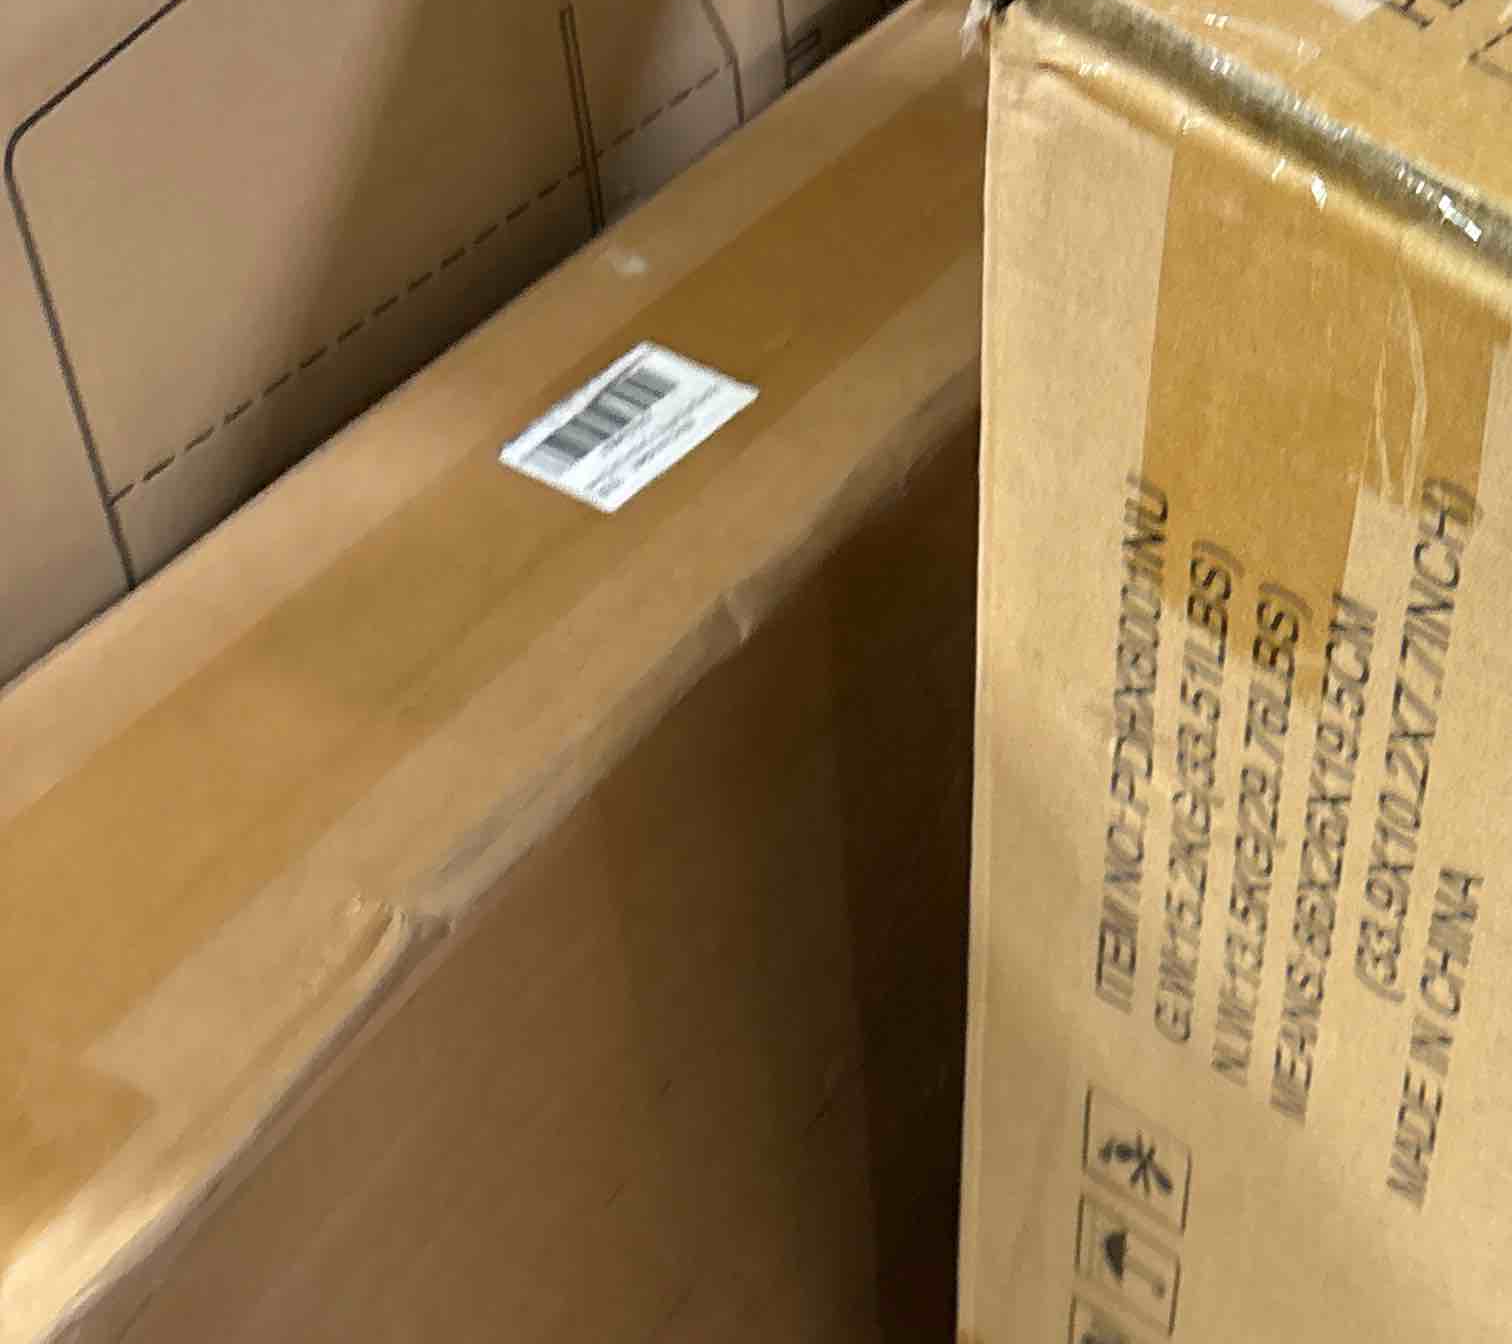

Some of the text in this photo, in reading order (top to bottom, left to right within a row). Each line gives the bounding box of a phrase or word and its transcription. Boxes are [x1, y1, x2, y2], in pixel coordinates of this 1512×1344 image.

[1108, 470, 1172, 817] PDHX8001NU
[1094, 888, 1139, 1018] ITEM
[1386, 852, 1483, 1209] MADE IN CHINA
